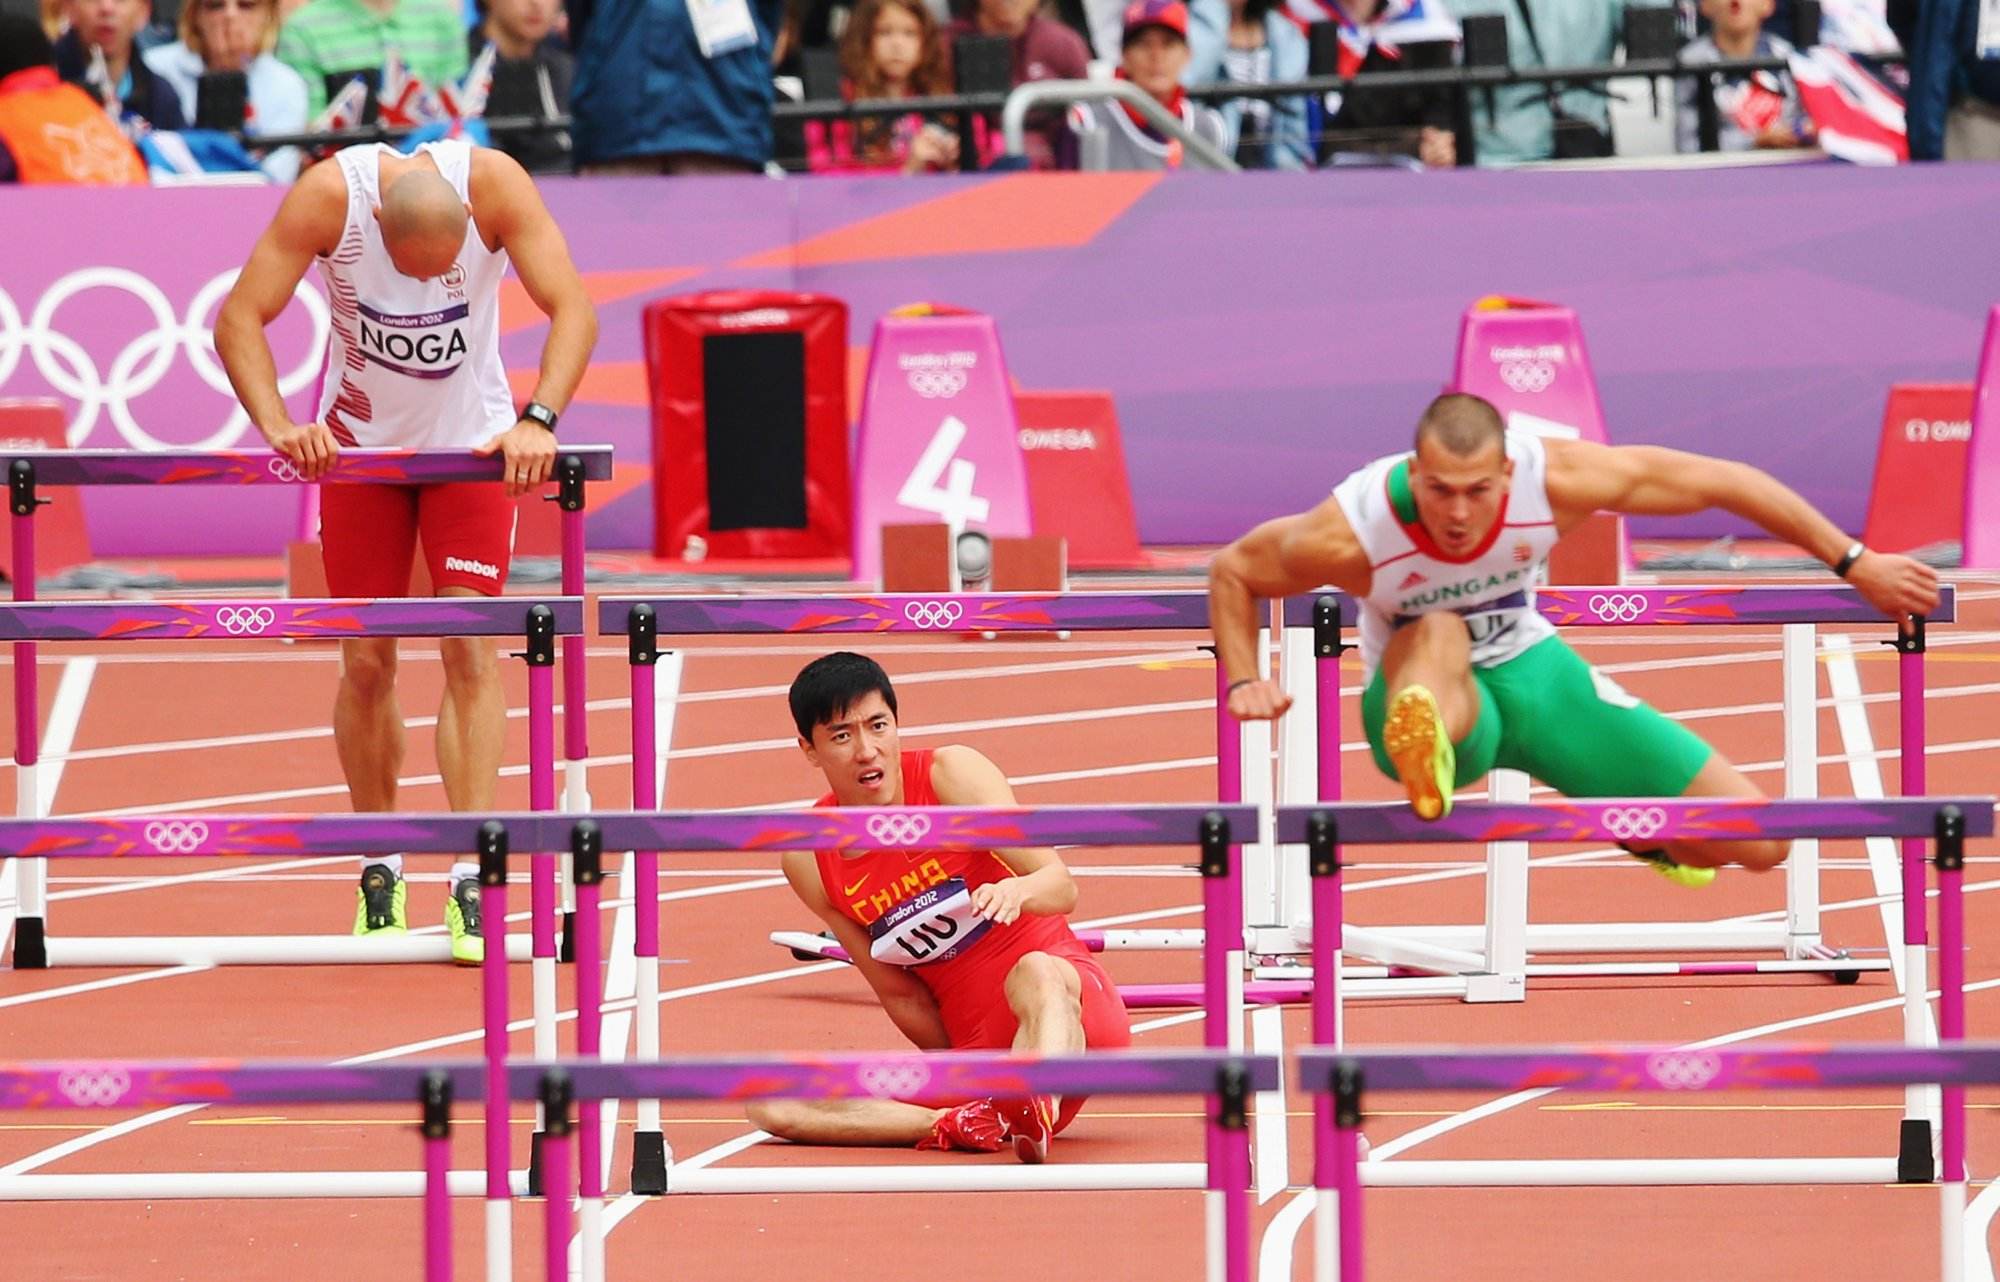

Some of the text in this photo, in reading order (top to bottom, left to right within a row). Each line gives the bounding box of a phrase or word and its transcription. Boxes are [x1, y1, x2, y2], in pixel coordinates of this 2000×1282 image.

[379, 315, 419, 327] London
[360, 320, 468, 364] NOGA
[1020, 427, 1096, 450] OMEGA
[896, 415, 990, 541] 4
[445, 556, 500, 580] Reebok
[850, 857, 949, 926] CHINA
[884, 890, 939, 927] London 2012
[895, 913, 958, 960] LIU
